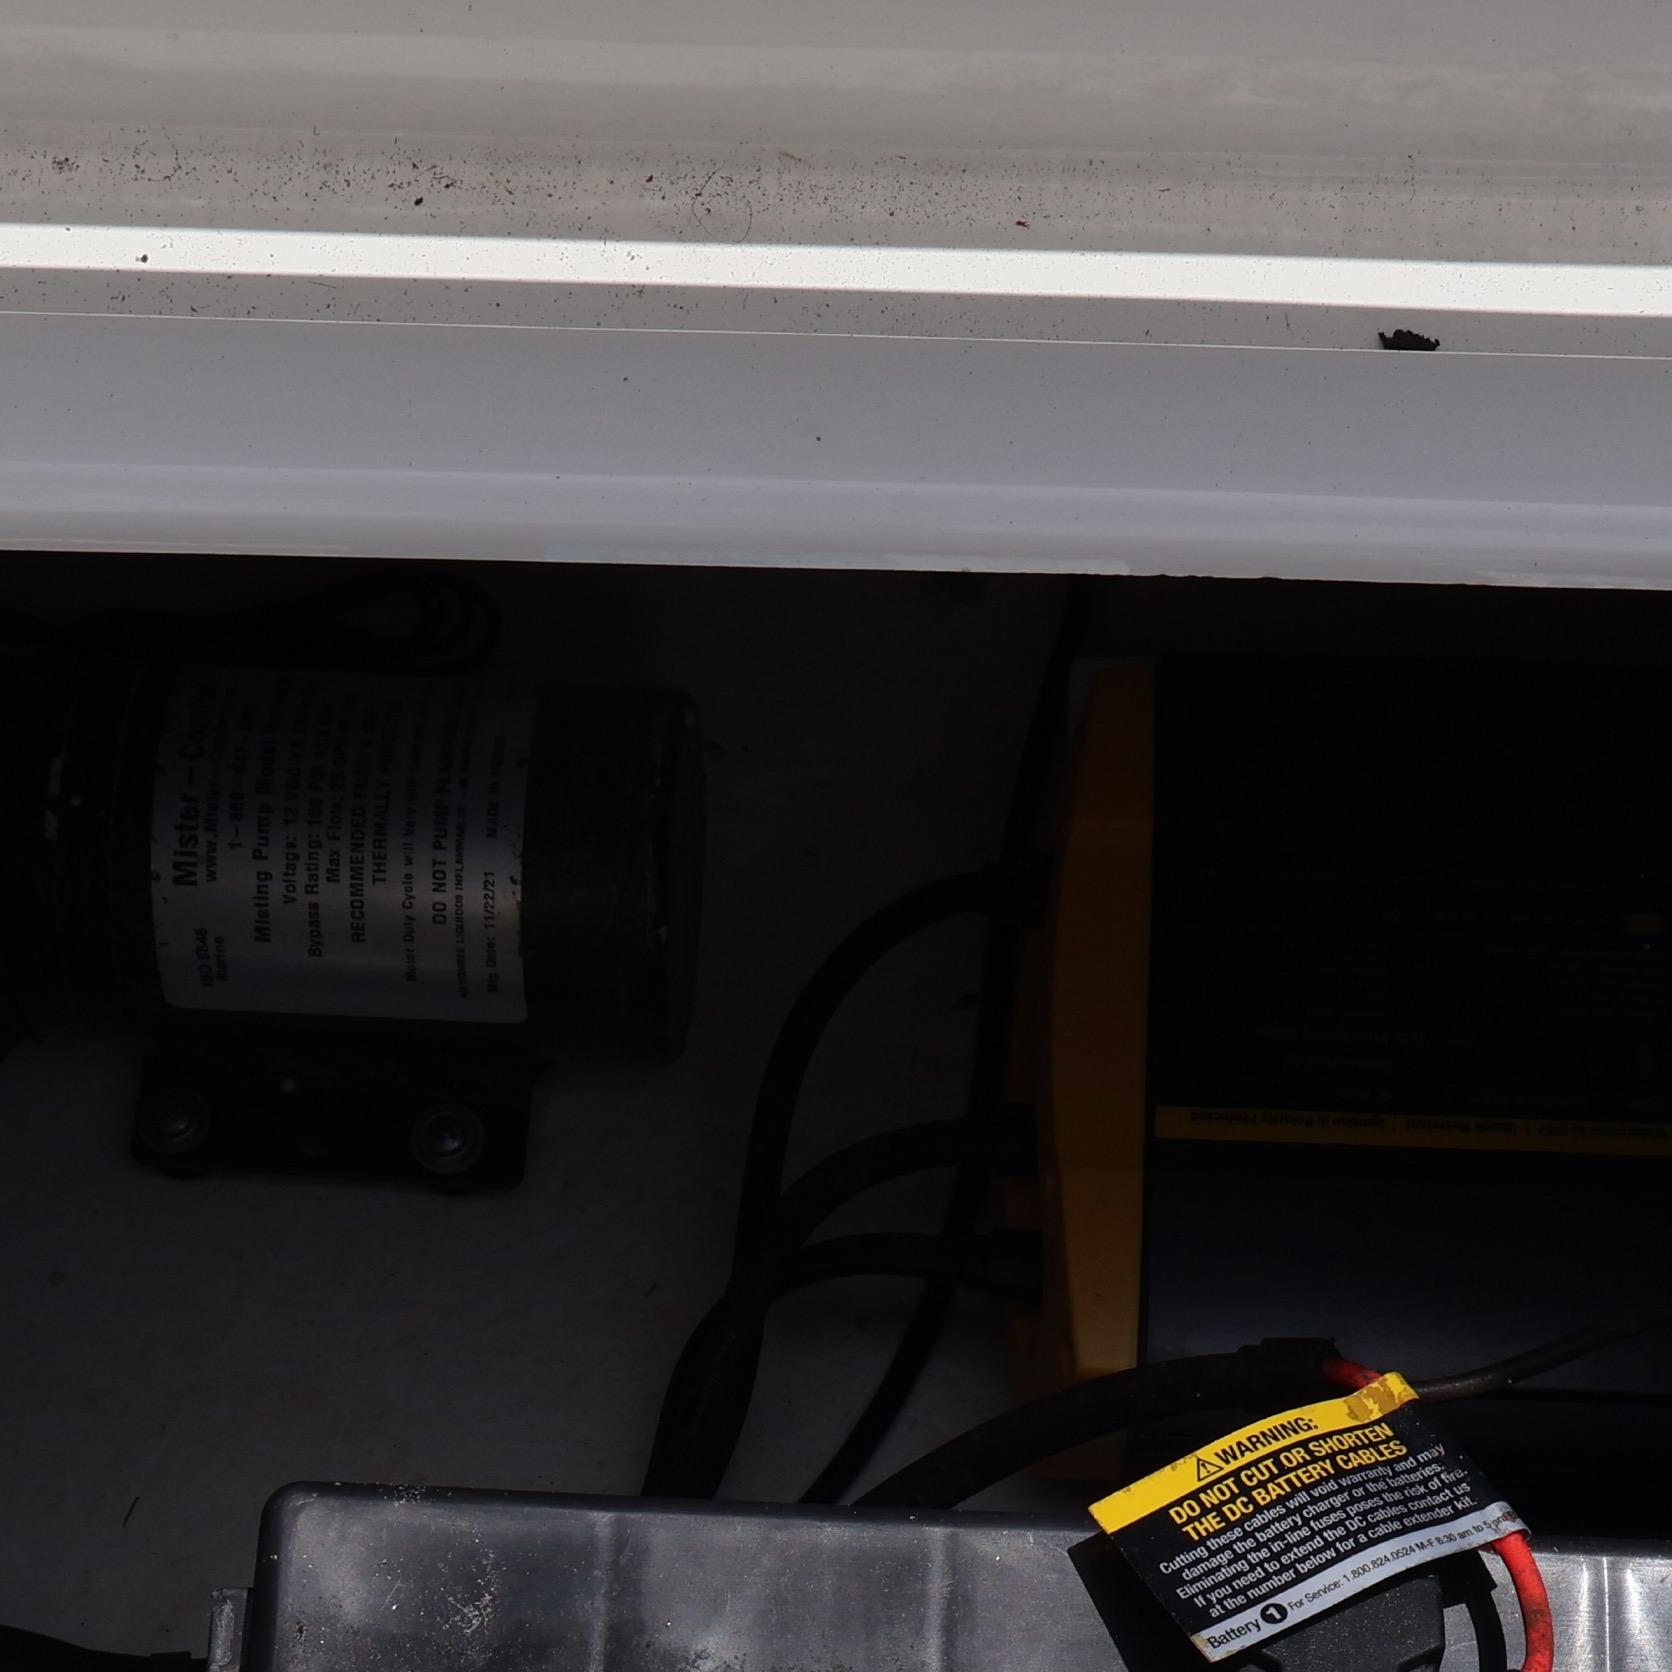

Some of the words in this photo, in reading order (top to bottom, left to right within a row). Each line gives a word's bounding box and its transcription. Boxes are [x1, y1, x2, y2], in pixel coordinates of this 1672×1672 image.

[173, 793, 200, 886] Mister
[252, 803, 274, 860] Pump
[372, 782, 390, 886] THERMALLY
[432, 800, 450, 851] PUMP
[282, 835, 299, 904] Voltage:
[304, 832, 323, 895] Rating:
[350, 805, 367, 943] RECOMMENDED
[431, 857, 447, 894] NOT
[254, 870, 272, 942] Misting
[307, 902, 324, 957] Bypass
[431, 902, 447, 925] DO
[1214, 1416, 1319, 1466] WARNING:
[1168, 1499, 1201, 1525] DO
[1199, 1477, 1240, 1509] NOT
[1240, 1457, 1279, 1488] CUT
[1281, 1446, 1310, 1469] OR
[1308, 1421, 1396, 1458] SHORTEN
[1182, 1510, 1227, 1541] THE
[1223, 1496, 1255, 1521] DC
[1251, 1460, 1336, 1507] BATTERY
[1336, 1439, 1409, 1472] CABLES
[1159, 1544, 1209, 1575] Cutting
[1208, 1526, 1244, 1551] these
[1243, 1503, 1288, 1531] cables
[1286, 1489, 1310, 1511] will
[1310, 1480, 1340, 1501] void
[1340, 1463, 1393, 1489] warranty
[1393, 1456, 1416, 1476] and
[1417, 1442, 1447, 1466] may
[1288, 1595, 1306, 1611] For
[1305, 1578, 1345, 1602] Service:
[1207, 1619, 1261, 1649] Battery
